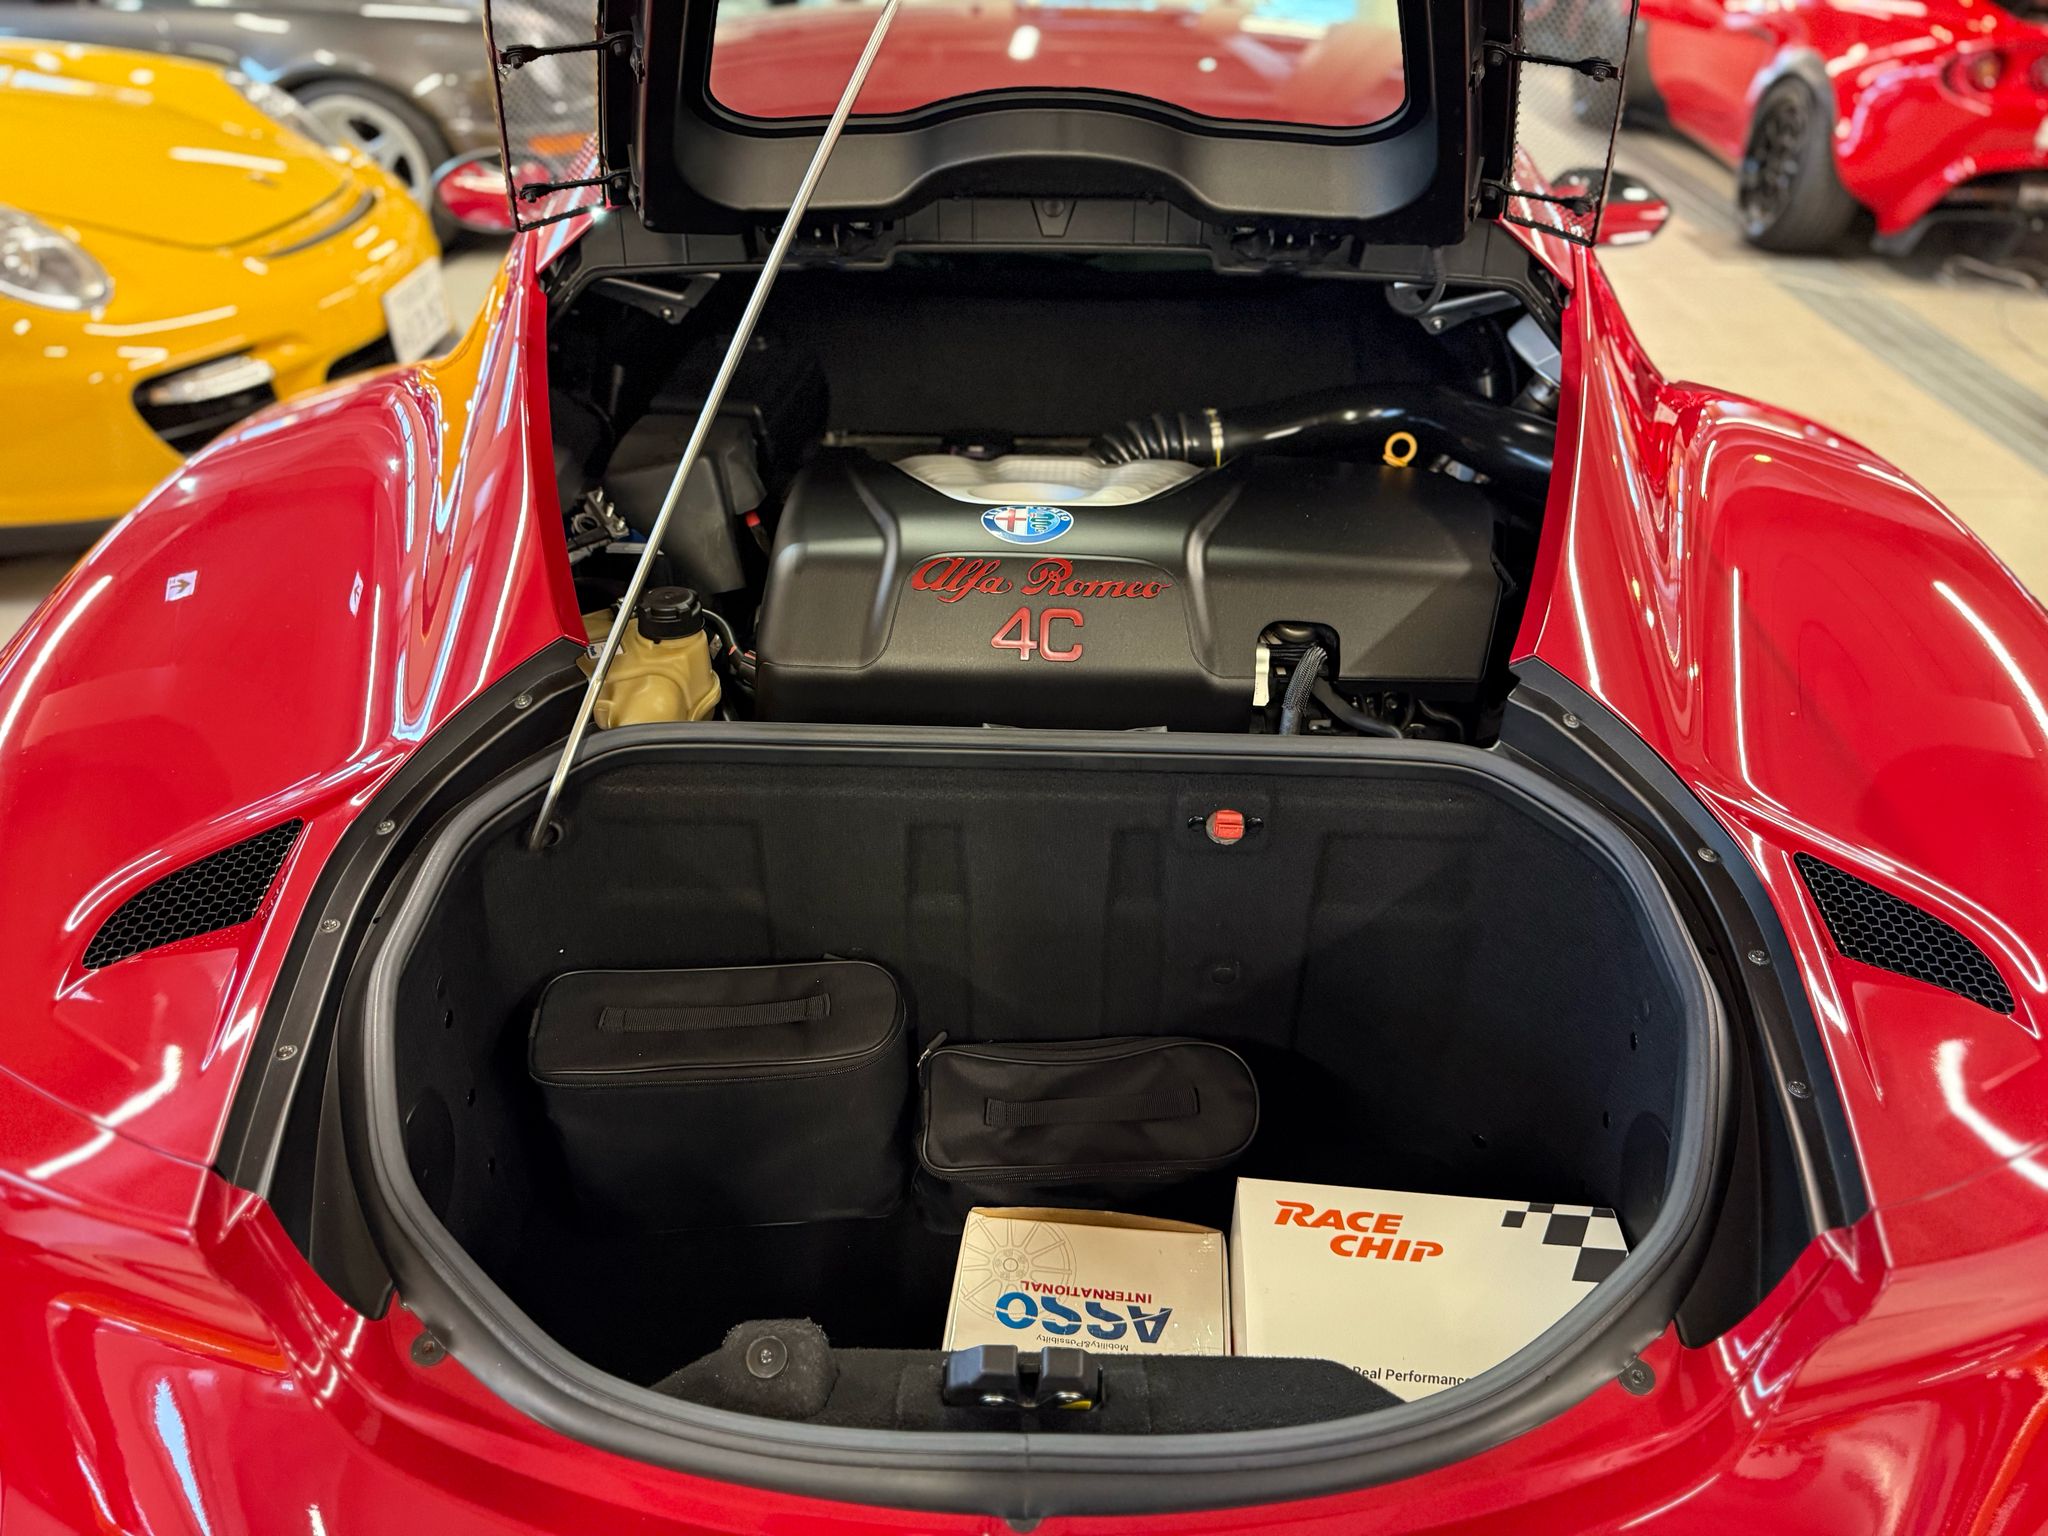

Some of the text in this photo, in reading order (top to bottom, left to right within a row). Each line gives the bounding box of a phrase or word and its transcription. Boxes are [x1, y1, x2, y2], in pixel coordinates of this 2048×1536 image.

[911, 557, 1173, 603] Alfa Romeo
[990, 606, 1084, 662] 4C
[1274, 1199, 1404, 1235] RACE
[1329, 1234, 1444, 1263] CHIP
[1020, 1280, 1152, 1304] INTERNATIONAL
[995, 1291, 1173, 1344] ASSO
